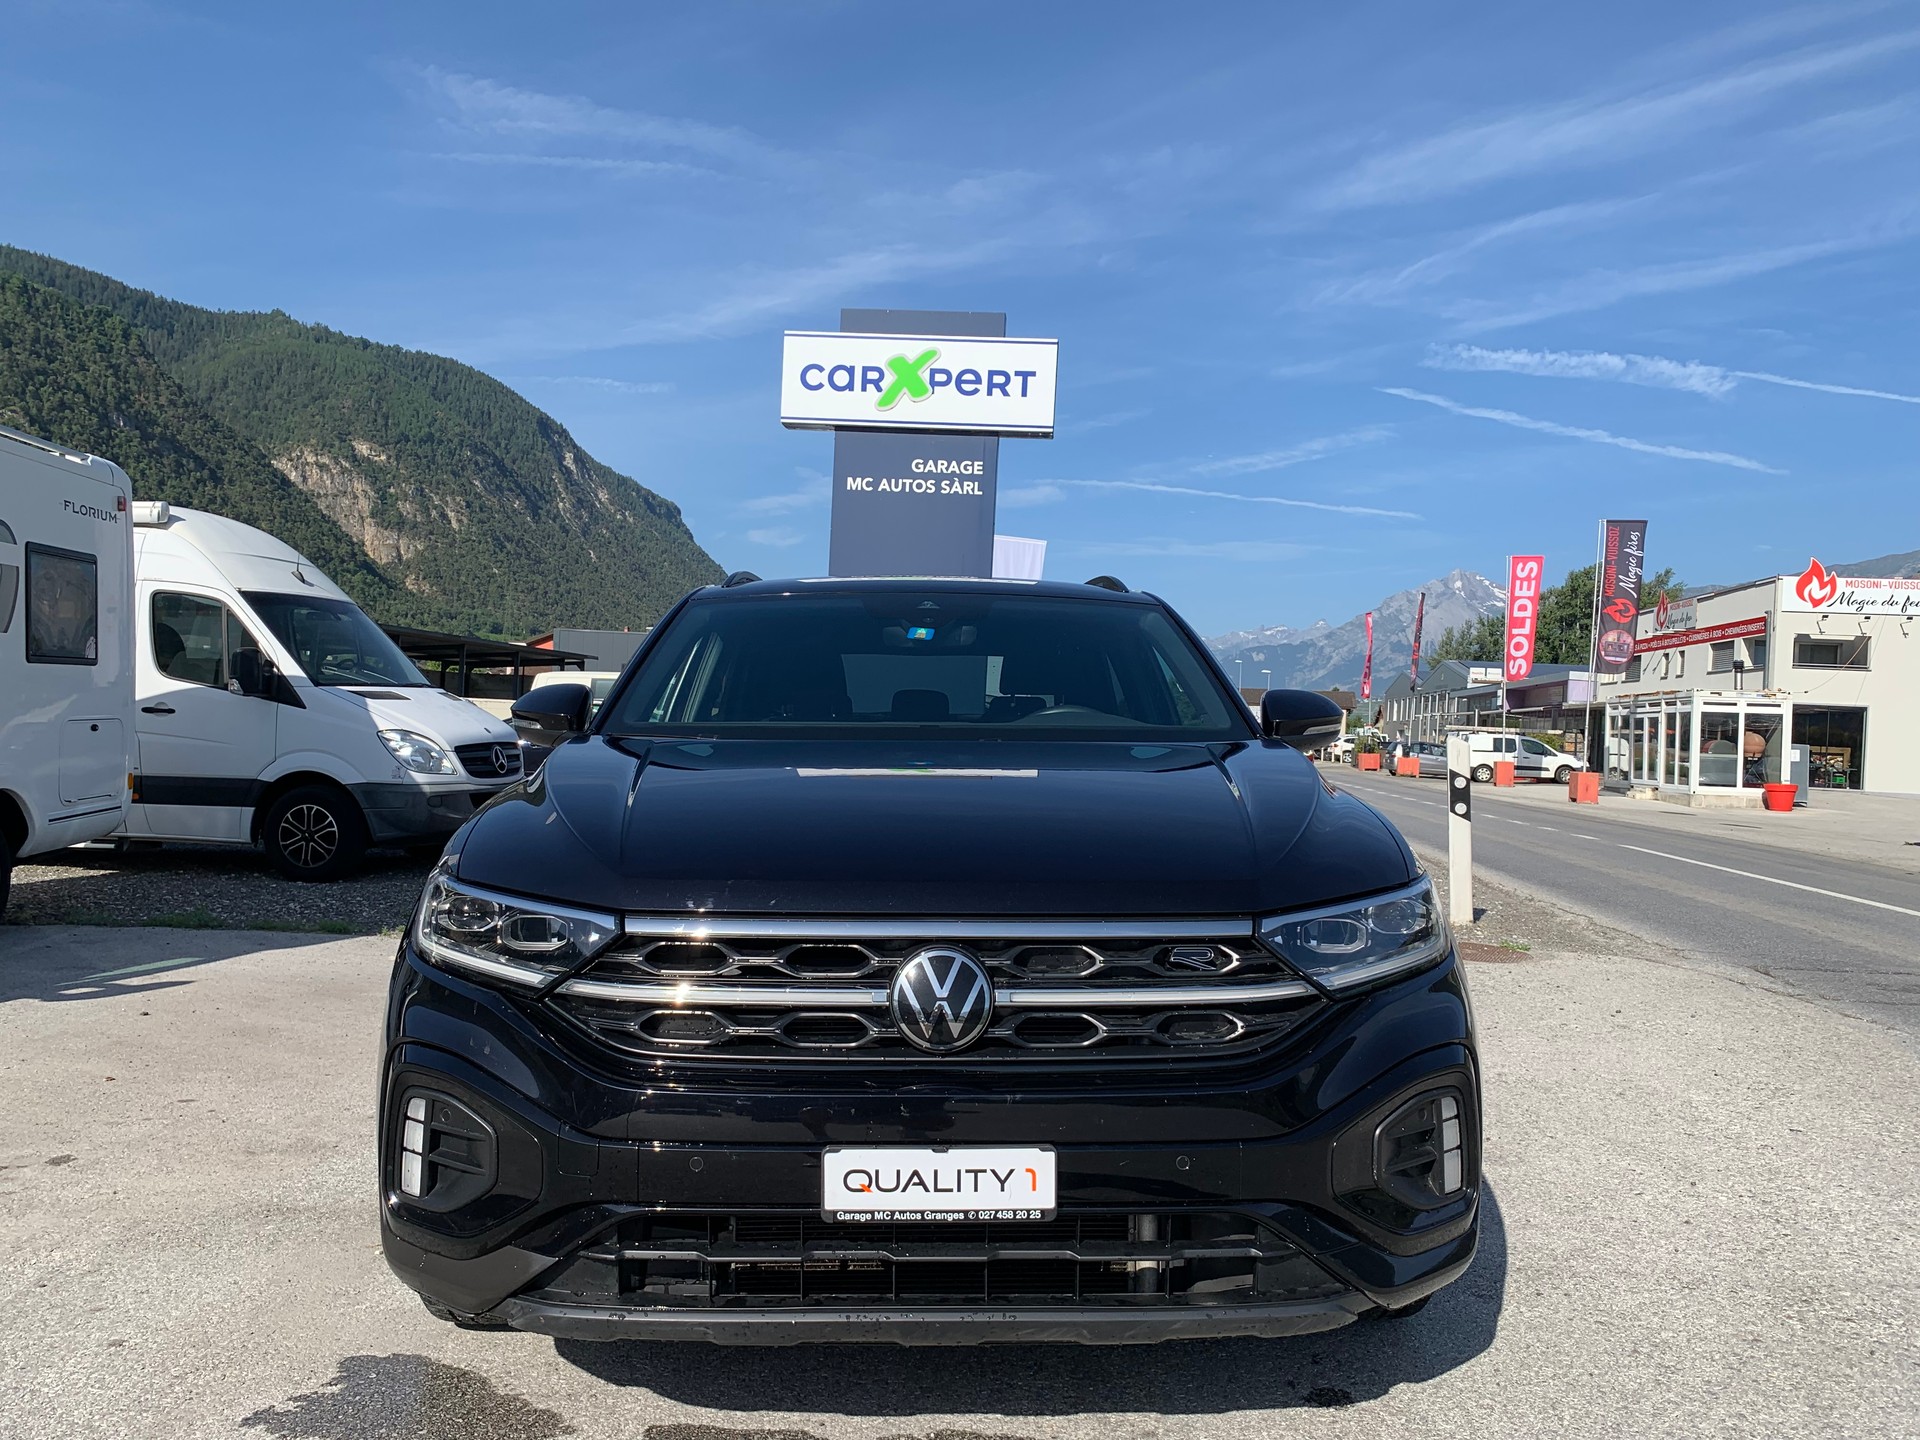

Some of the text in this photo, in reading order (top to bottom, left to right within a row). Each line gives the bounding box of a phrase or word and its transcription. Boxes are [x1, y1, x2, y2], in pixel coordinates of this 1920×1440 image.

[911, 459, 983, 475] GARAGE
[846, 476, 983, 495] MC AUTOS SÀRL
[63, 499, 118, 524] FLORIUM
[1604, 526, 1620, 597] MOSONI-VUISSOZ
[1618, 530, 1644, 599] Magic fires
[1826, 590, 1879, 613] Magie
[1881, 594, 1900, 607] du
[1509, 561, 1538, 675] SOLDES
[843, 1168, 1016, 1193] QUALITY
[836, 1211, 1042, 1222] Garage MC Autos Granges 027 458 20 25
